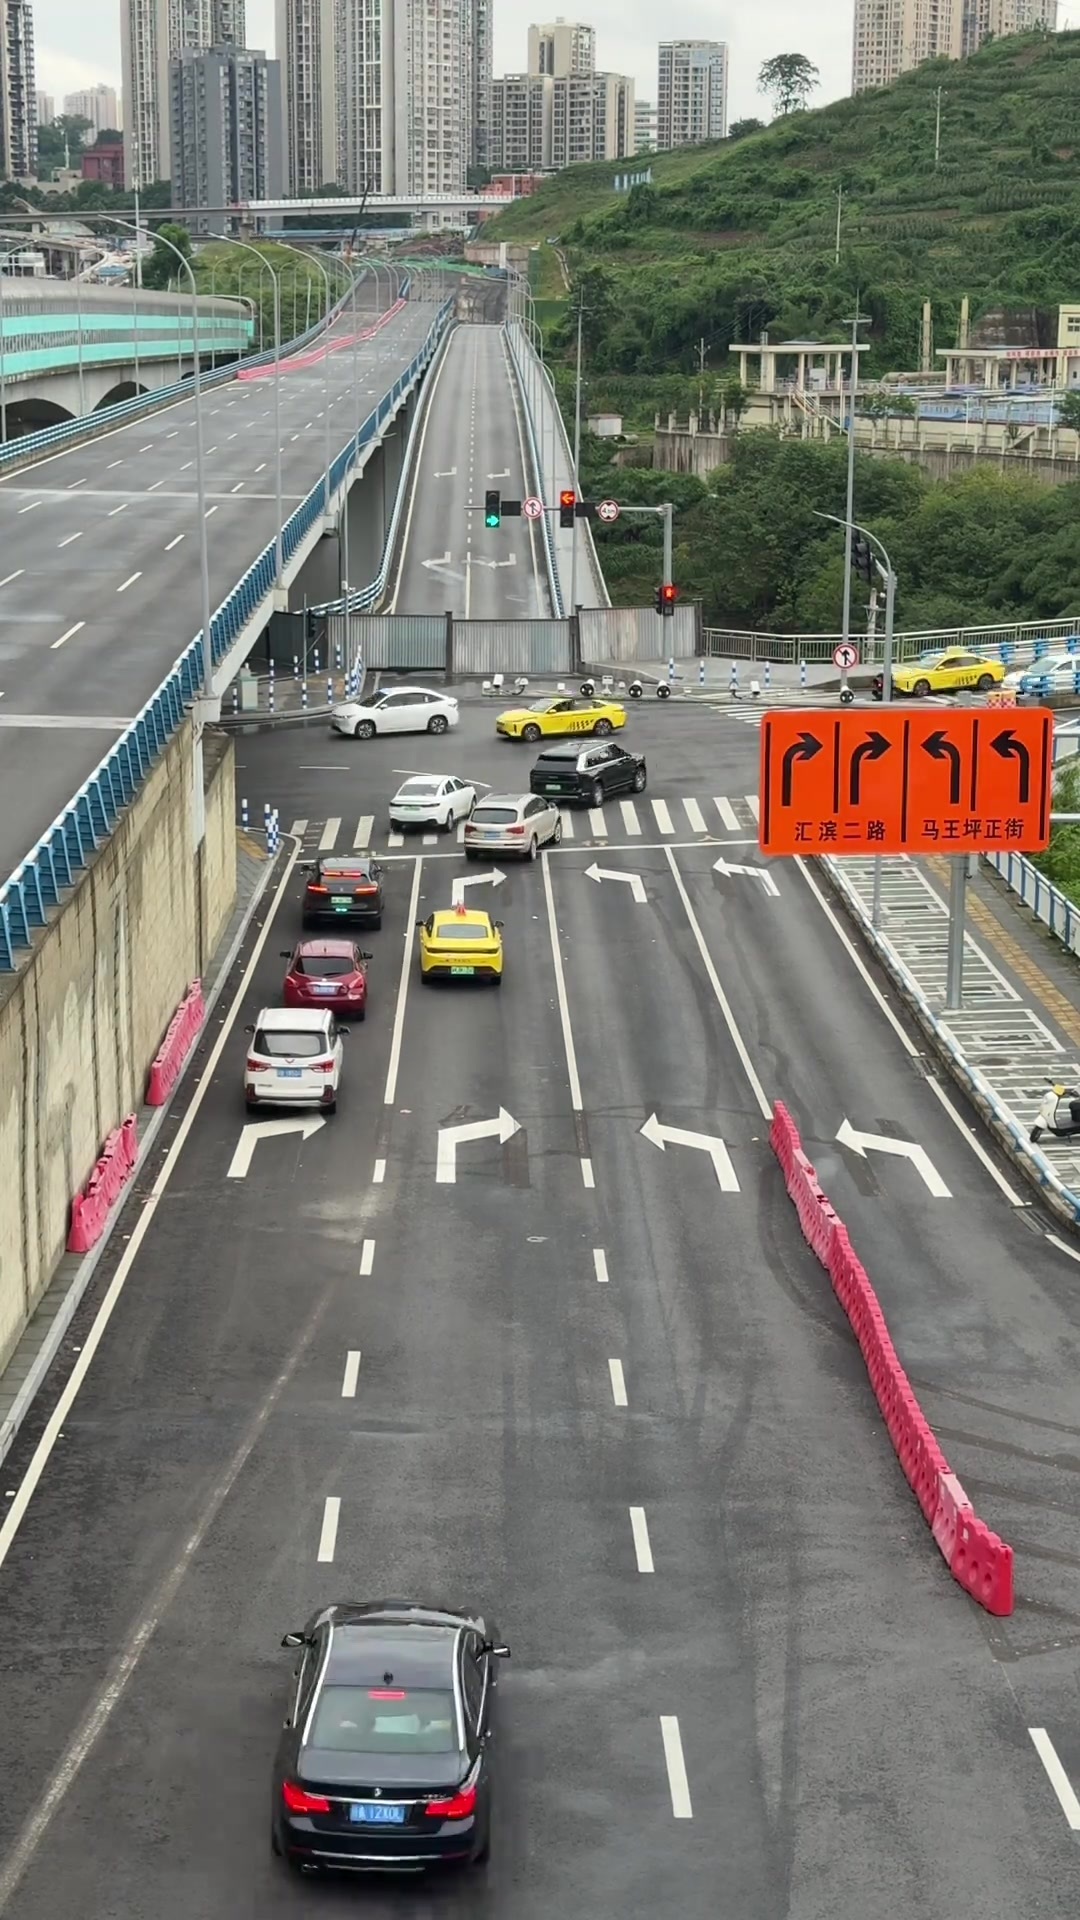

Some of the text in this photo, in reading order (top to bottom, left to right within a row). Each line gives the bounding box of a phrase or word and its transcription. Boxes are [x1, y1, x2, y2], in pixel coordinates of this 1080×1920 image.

[794, 820, 886, 842] 汇滨二路
[921, 818, 1024, 840] 马王坪正街
